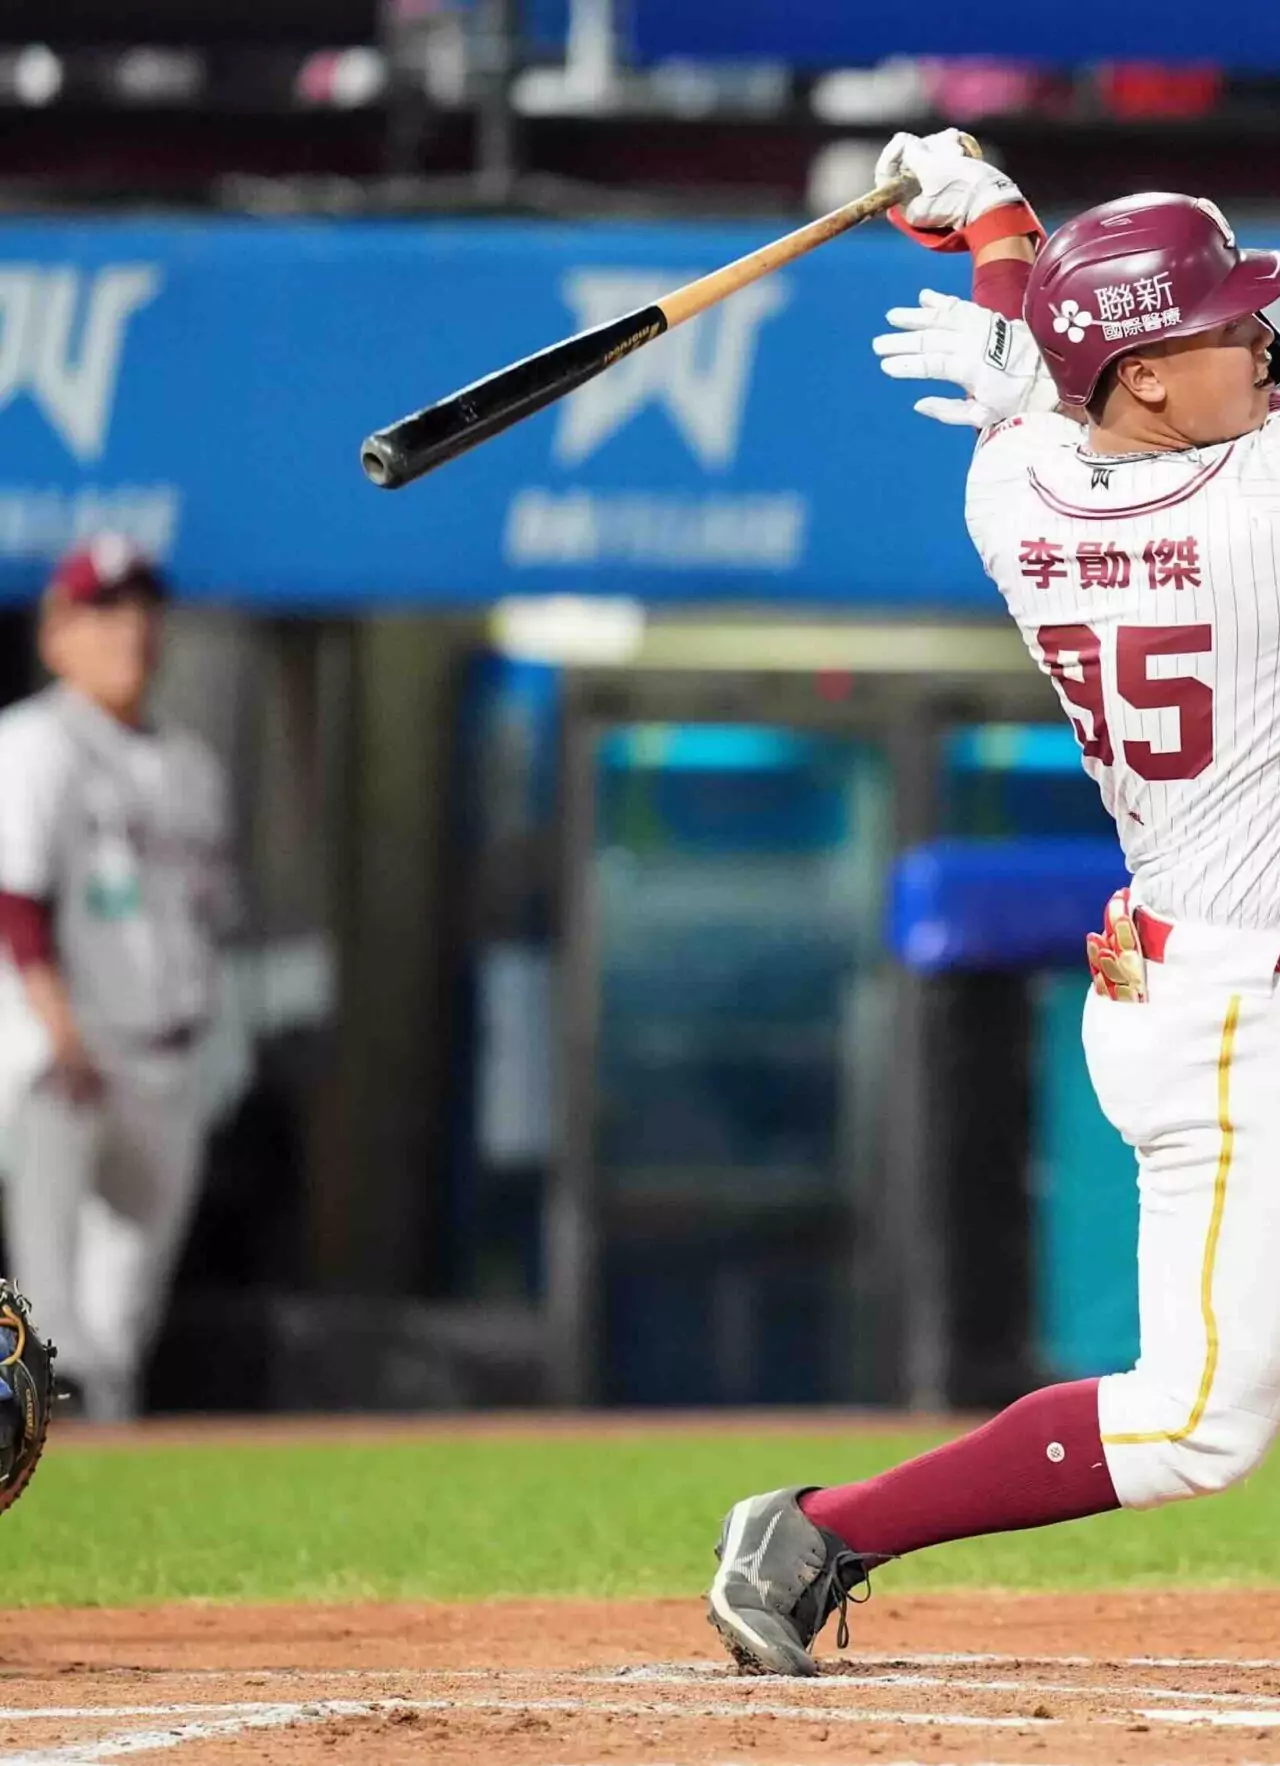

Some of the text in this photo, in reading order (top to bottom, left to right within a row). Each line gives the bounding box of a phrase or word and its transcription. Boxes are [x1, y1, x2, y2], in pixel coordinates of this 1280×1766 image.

[1094, 271, 1173, 321] 聯新
[1102, 307, 1182, 341] 國際醫療
[1018, 536, 1202, 590] 李勛傑
[1037, 623, 1214, 782] 95
